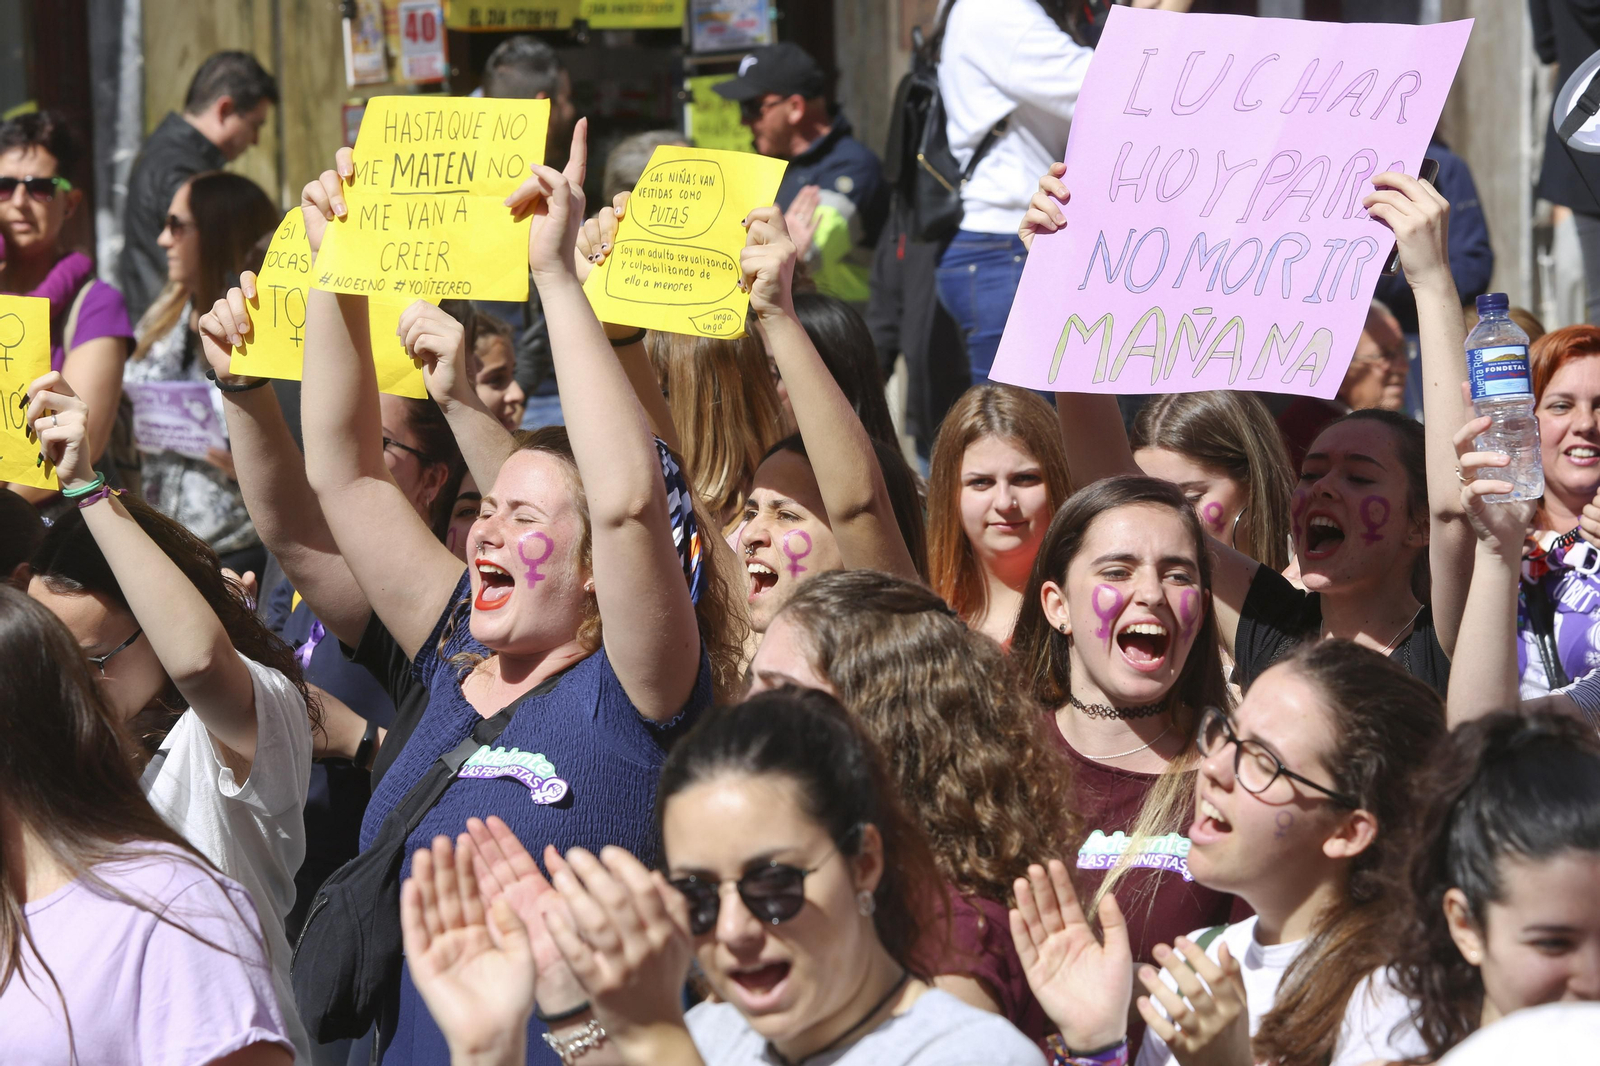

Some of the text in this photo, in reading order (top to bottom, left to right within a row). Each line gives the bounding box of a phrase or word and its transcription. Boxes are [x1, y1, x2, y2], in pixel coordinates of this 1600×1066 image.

[405, 11, 436, 43] 40
[1123, 48, 1422, 124] LUCHAR
[492, 113, 528, 142] NO
[353, 150, 524, 188] ME MATEN NO
[650, 168, 715, 187] LAS NIÑAS VAN
[1108, 141, 1257, 218] HOY
[638, 187, 702, 200] VESTIDAS COMO
[359, 196, 467, 231] ME VAN A
[649, 204, 689, 224] PUTAS
[280, 221, 296, 240] SI
[265, 251, 309, 273] TOCAS
[380, 240, 450, 272] CREER
[636, 247, 645, 256] un
[647, 248, 674, 261] adulto
[1077, 227, 1380, 303] NO MORIR
[318, 272, 386, 291] #NOESNO
[620, 260, 711, 280] y culpabilizando de
[624, 274, 641, 286] ello
[653, 281, 693, 292] menores
[702, 323, 723, 333] unga
[1047, 306, 1334, 387] MAÑANA
[1472, 349, 1486, 398] Huerta Ríos
[1485, 365, 1526, 373] FONDETAL
[469, 745, 553, 776] Adelante
[458, 764, 543, 788] LAS FEMINISTAS
[1080, 830, 1192, 856] Adeante
[1078, 854, 1106, 867] LAS
